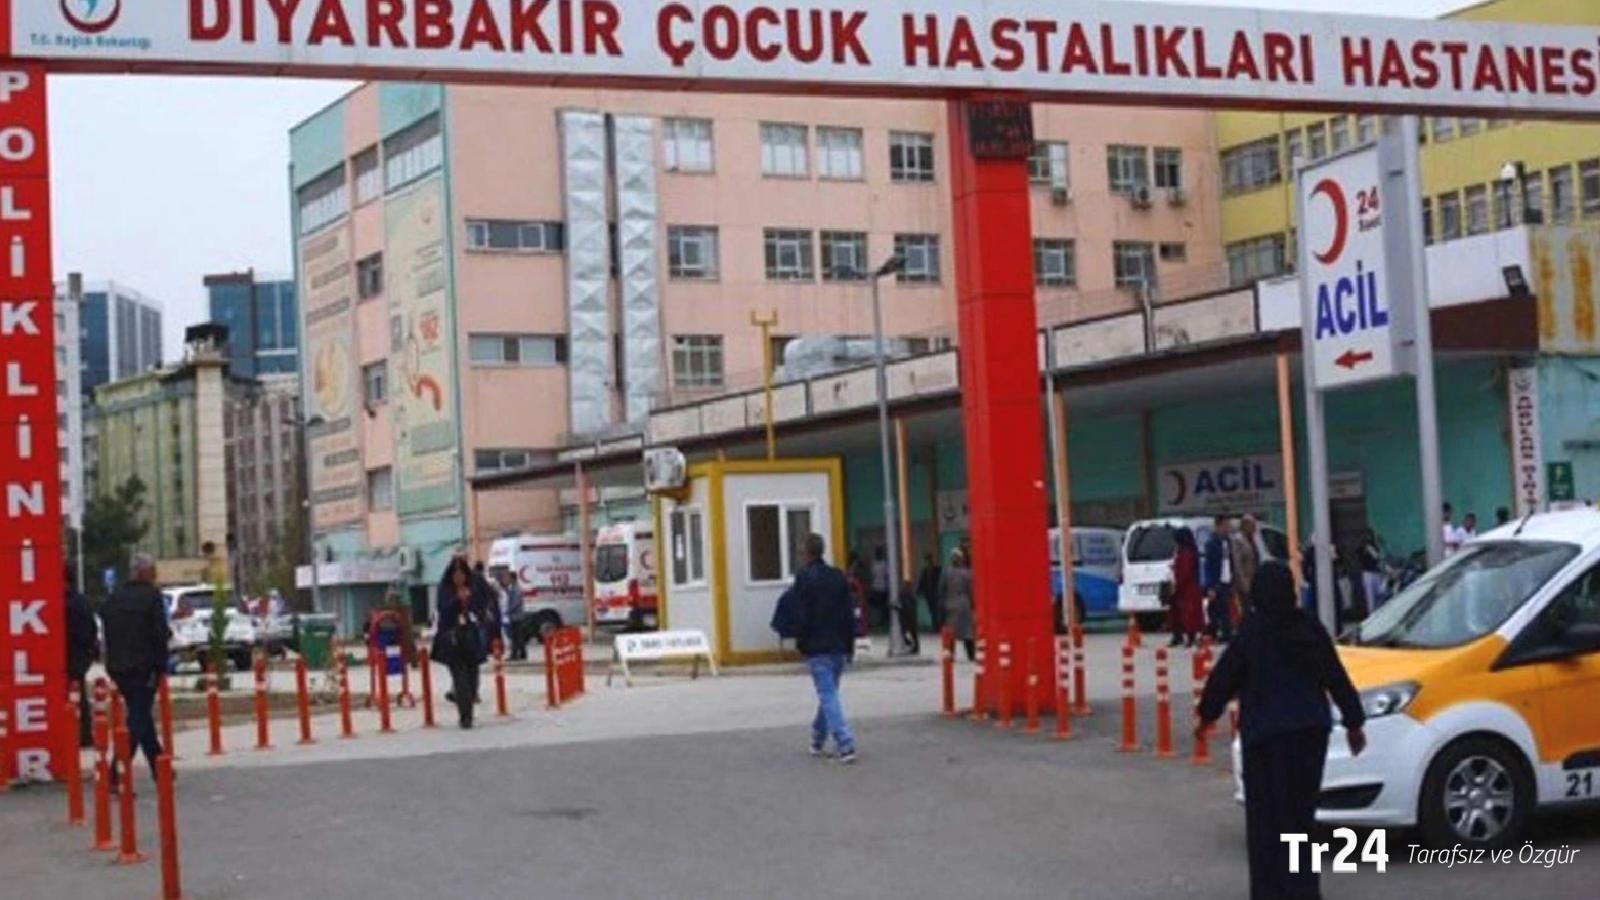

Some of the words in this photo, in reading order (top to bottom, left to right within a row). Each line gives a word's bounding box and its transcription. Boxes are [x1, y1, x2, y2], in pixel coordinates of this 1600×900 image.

[657, 2, 871, 66] ÇOCUK
[902, 14, 1315, 85] HASTALIKLARI
[1356, 186, 1379, 214] 24
[1315, 260, 1388, 340] ACİL
[1194, 459, 1275, 494] ACİL
[1565, 771, 1593, 797] 21
